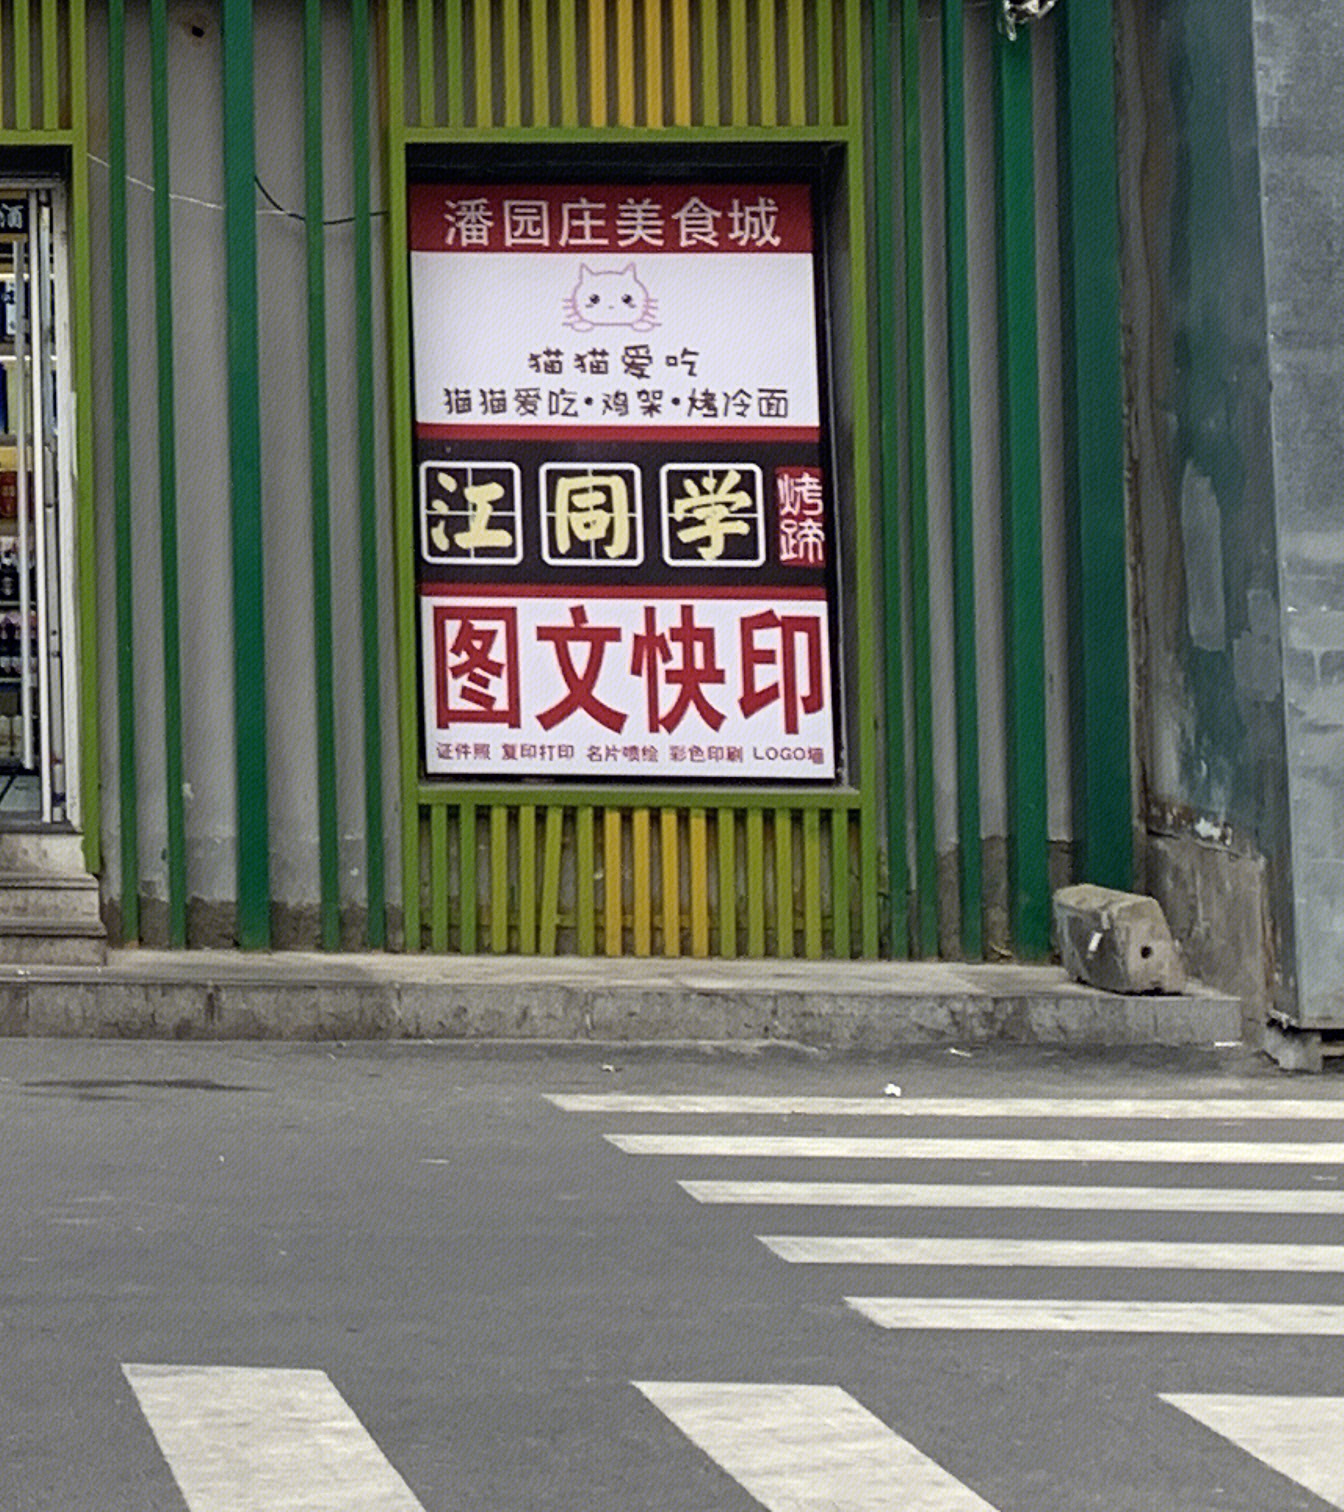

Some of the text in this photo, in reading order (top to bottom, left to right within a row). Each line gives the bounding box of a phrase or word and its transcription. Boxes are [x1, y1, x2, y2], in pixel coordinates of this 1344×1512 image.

[443, 198, 782, 248] 潘园庄美食城
[528, 345, 700, 380] 猫猫爱吃
[430, 468, 752, 561] 江同学
[432, 605, 825, 735] 图文快印
[436, 742, 491, 760] 证件照
[501, 743, 574, 761] 复印打印
[586, 745, 658, 762] 名片喷绘
[669, 745, 743, 763] 彩色印刷
